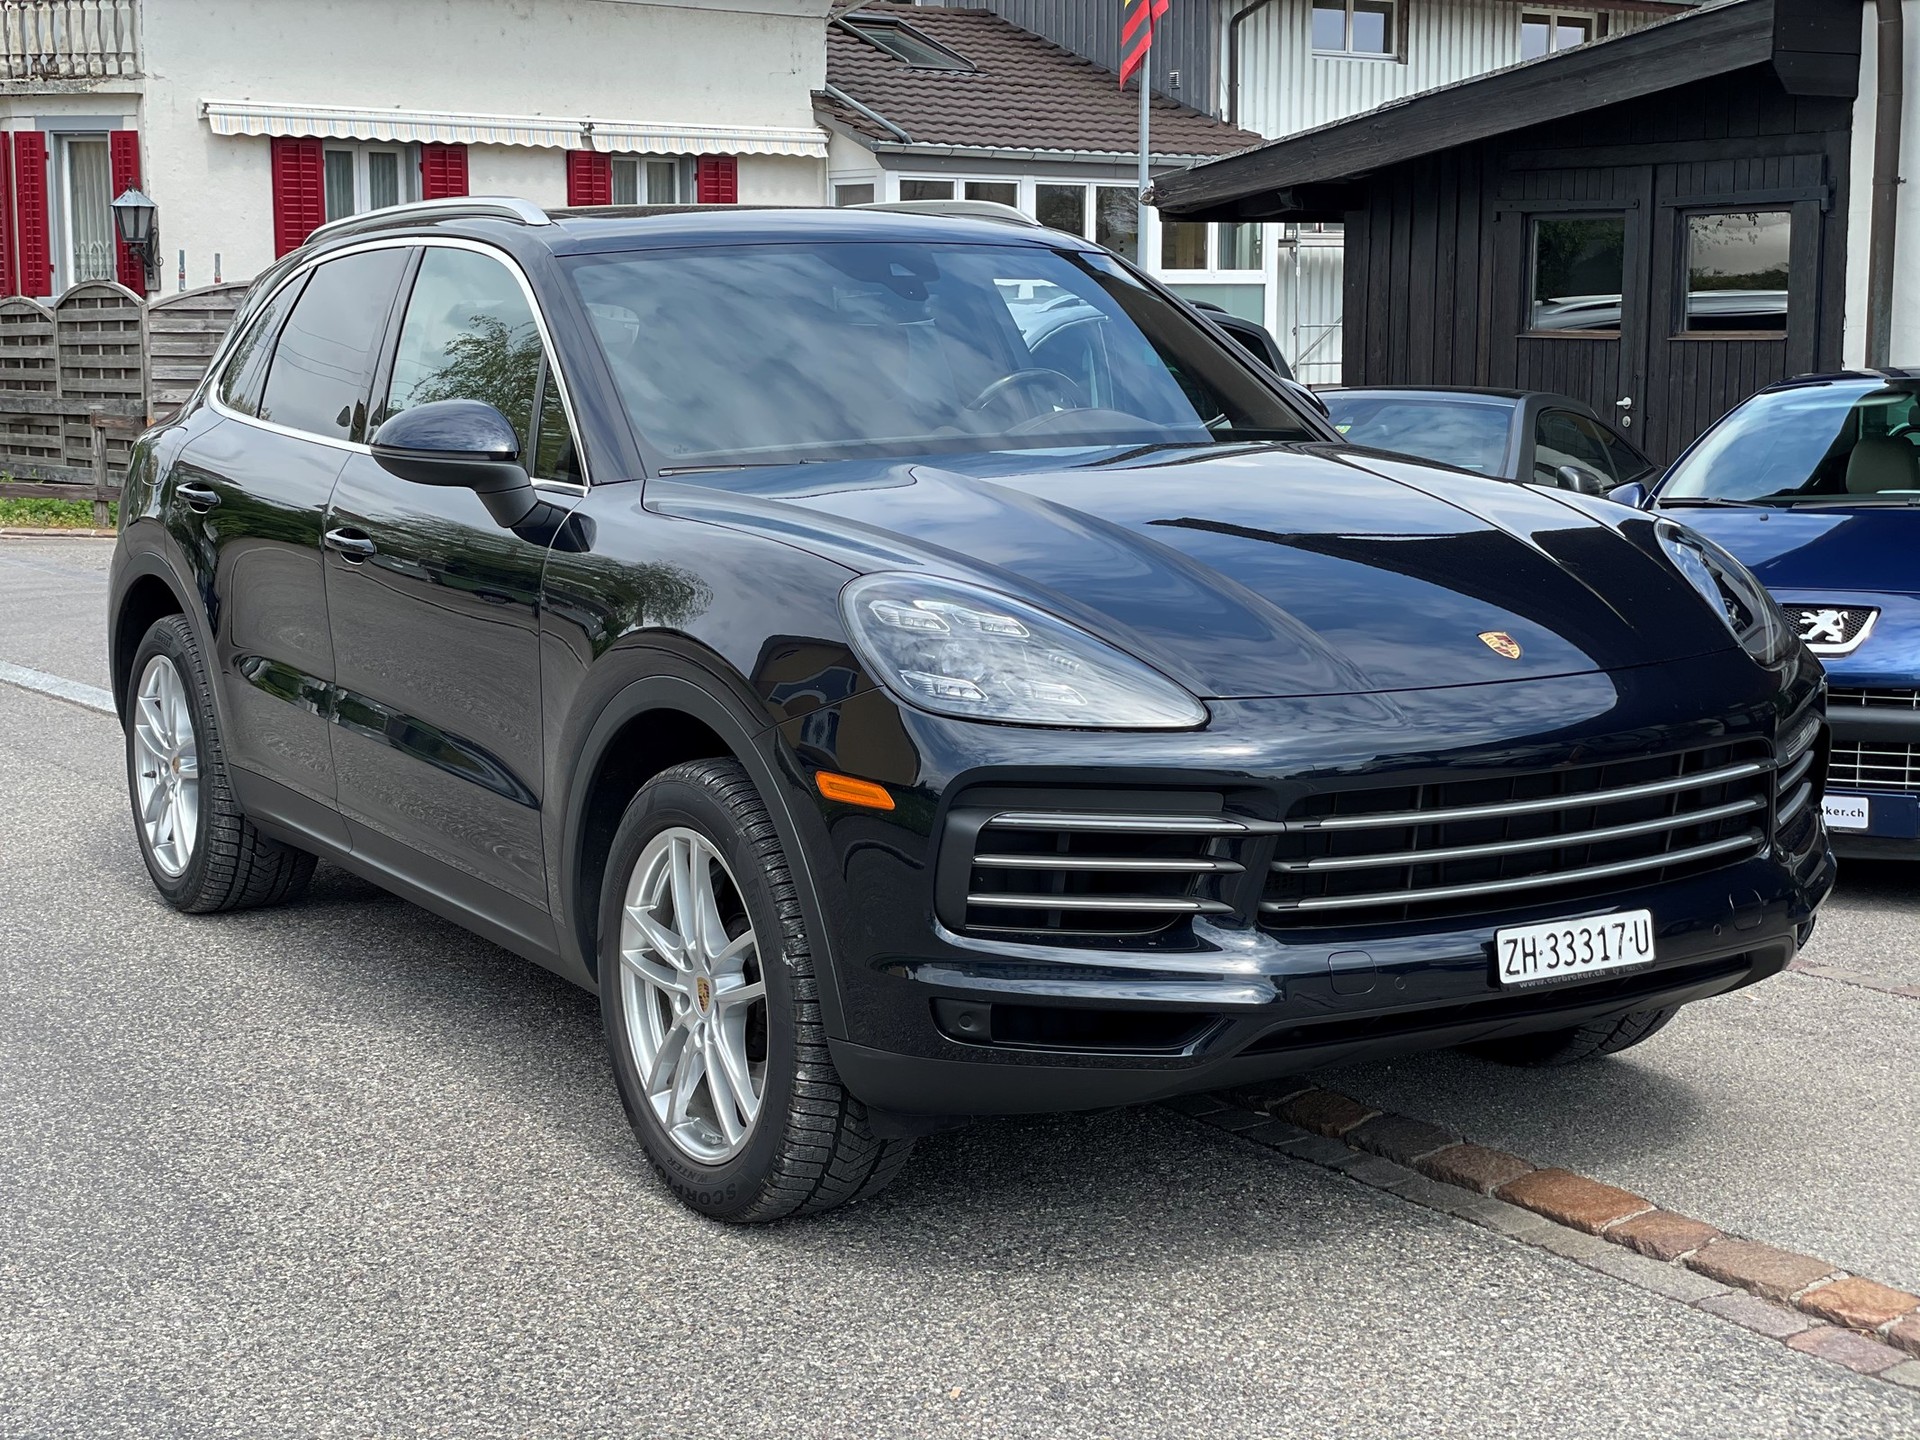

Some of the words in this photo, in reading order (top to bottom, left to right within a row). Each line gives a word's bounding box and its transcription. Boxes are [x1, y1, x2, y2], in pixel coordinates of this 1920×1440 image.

[1825, 806, 1865, 818] ker.ch
[643, 1145, 737, 1206] SCORPION
[666, 1157, 708, 1183] WINTER
